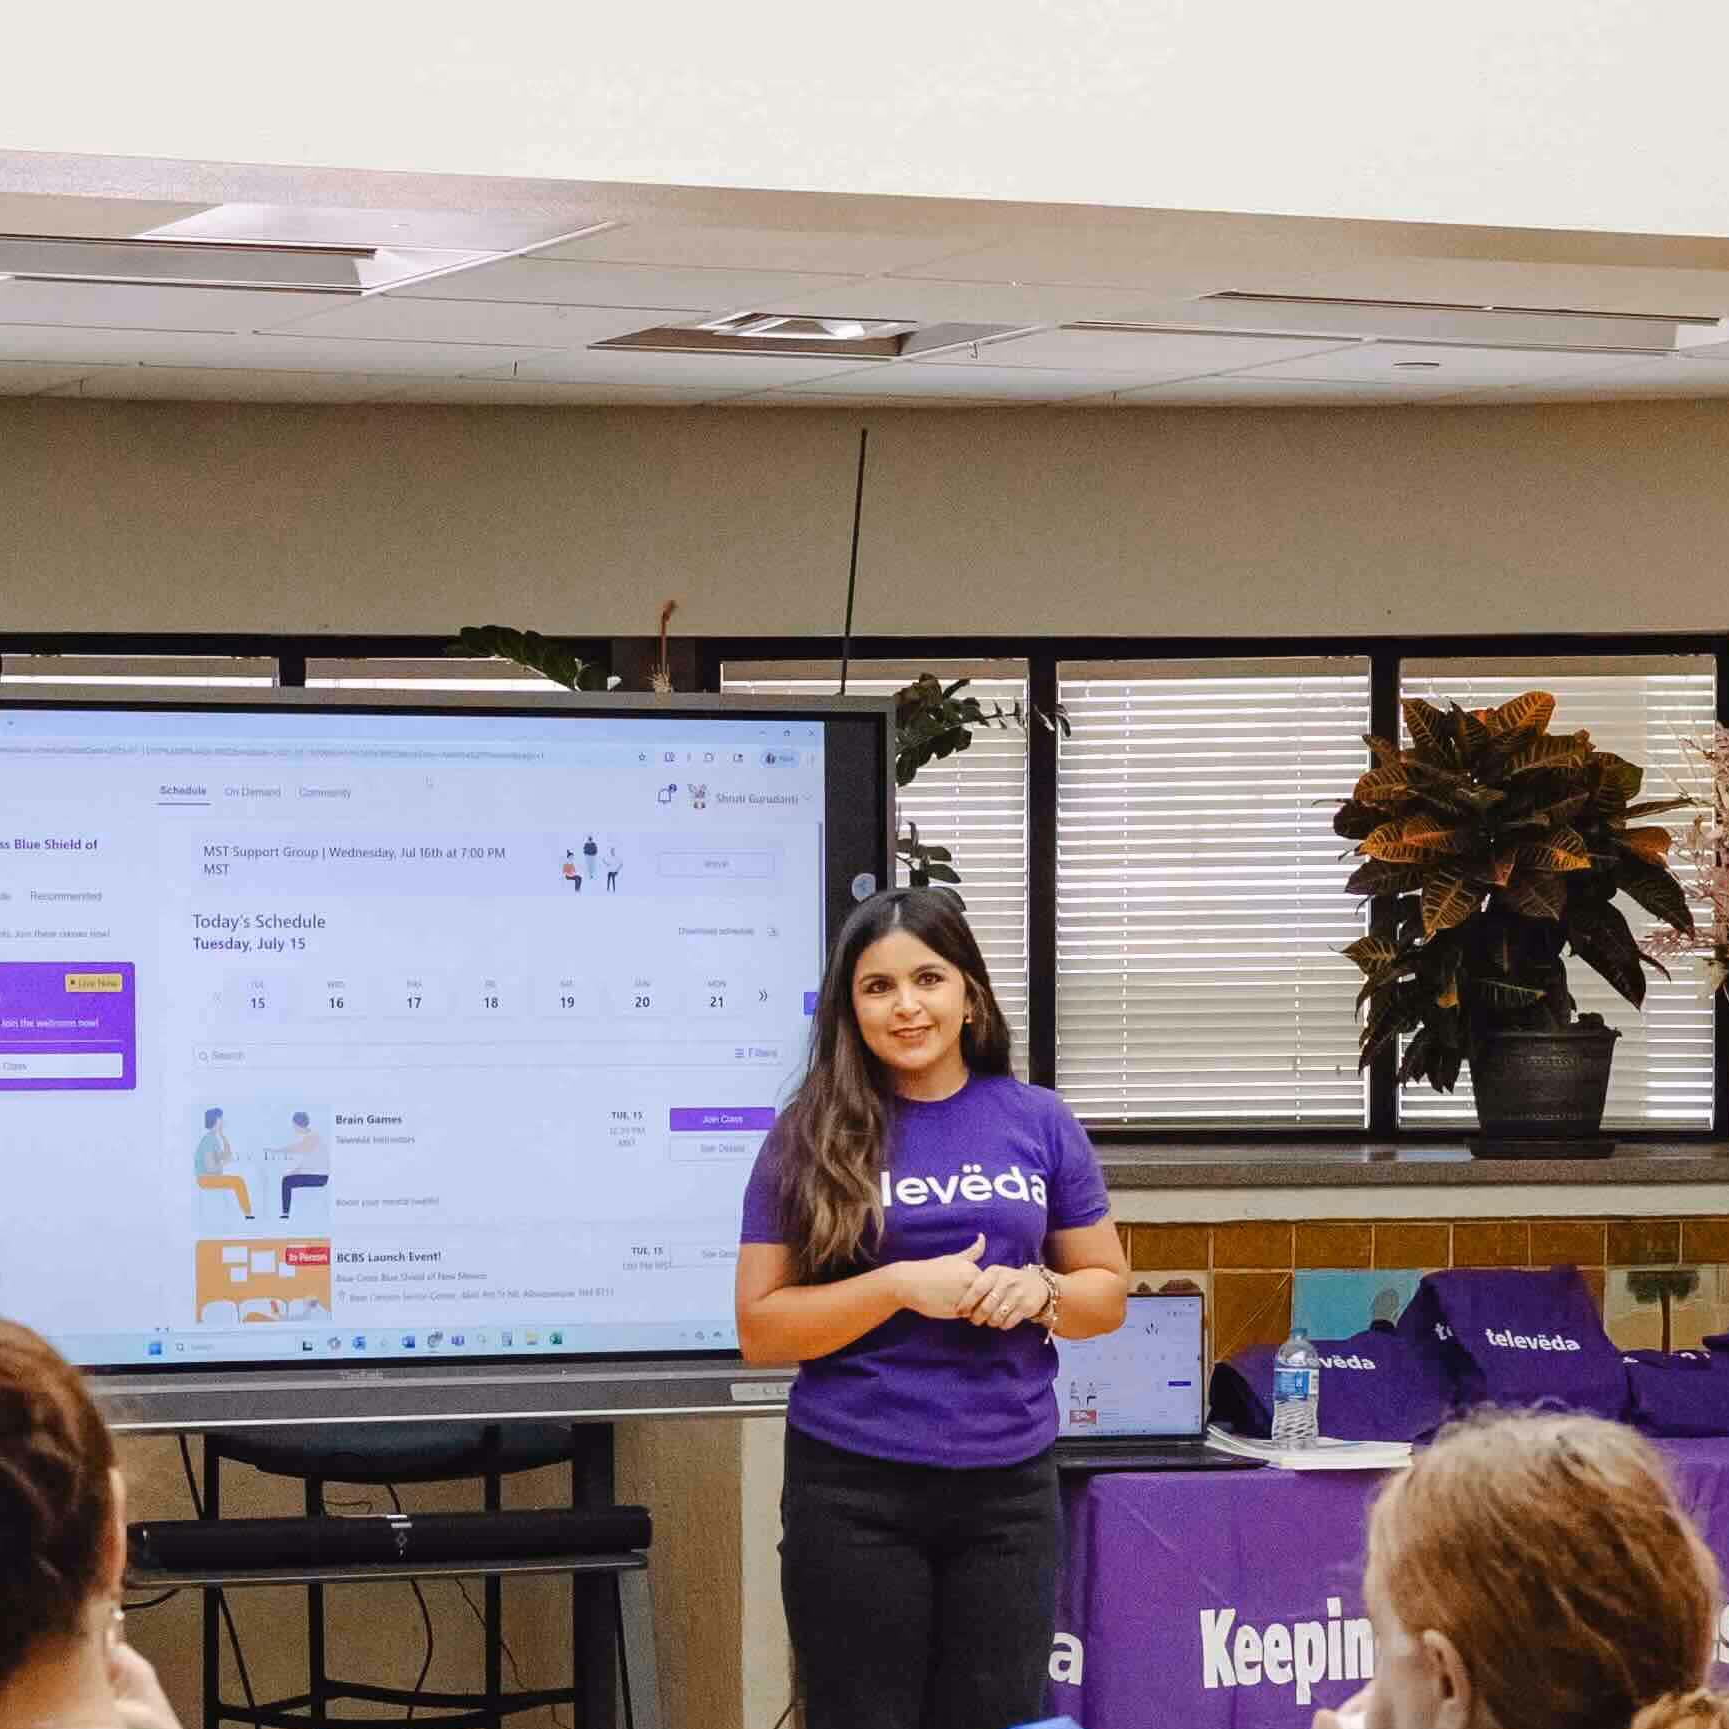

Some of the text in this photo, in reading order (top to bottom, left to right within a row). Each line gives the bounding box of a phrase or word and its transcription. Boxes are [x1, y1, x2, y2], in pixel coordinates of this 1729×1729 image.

[159, 785, 207, 796] Schedule
[241, 786, 281, 798] Demand
[14, 838, 41, 850] Blue
[44, 838, 82, 850] Shield
[85, 838, 98, 850] of
[203, 845, 229, 857] MST
[232, 846, 280, 862] Support
[283, 846, 319, 861] Group
[328, 846, 396, 862] Wednesday,
[400, 846, 416, 858] Jul
[419, 847, 444, 859] 16th
[446, 847, 459, 859] at
[461, 847, 484, 859] 7:00
[487, 847, 506, 859] PM
[203, 863, 229, 875] MST
[30, 890, 103, 902] Recommended
[191, 913, 326, 932] Today's Schedule
[192, 937, 306, 952] Tuesday, July 15
[250, 997, 266, 1009] 15
[328, 997, 345, 1009] 16
[406, 997, 422, 1009] 17
[483, 997, 499, 1009] 18
[560, 997, 575, 1009] 19
[634, 997, 650, 1009] 20
[709, 997, 724, 1009] 21
[335, 1114, 403, 1126] Brain Games
[879, 1164, 1048, 1209] levëda
[336, 1250, 442, 1264] BCBS Launch Event!
[1485, 1327, 1581, 1354] televëda
[1199, 1596, 1375, 1705] Keepin
